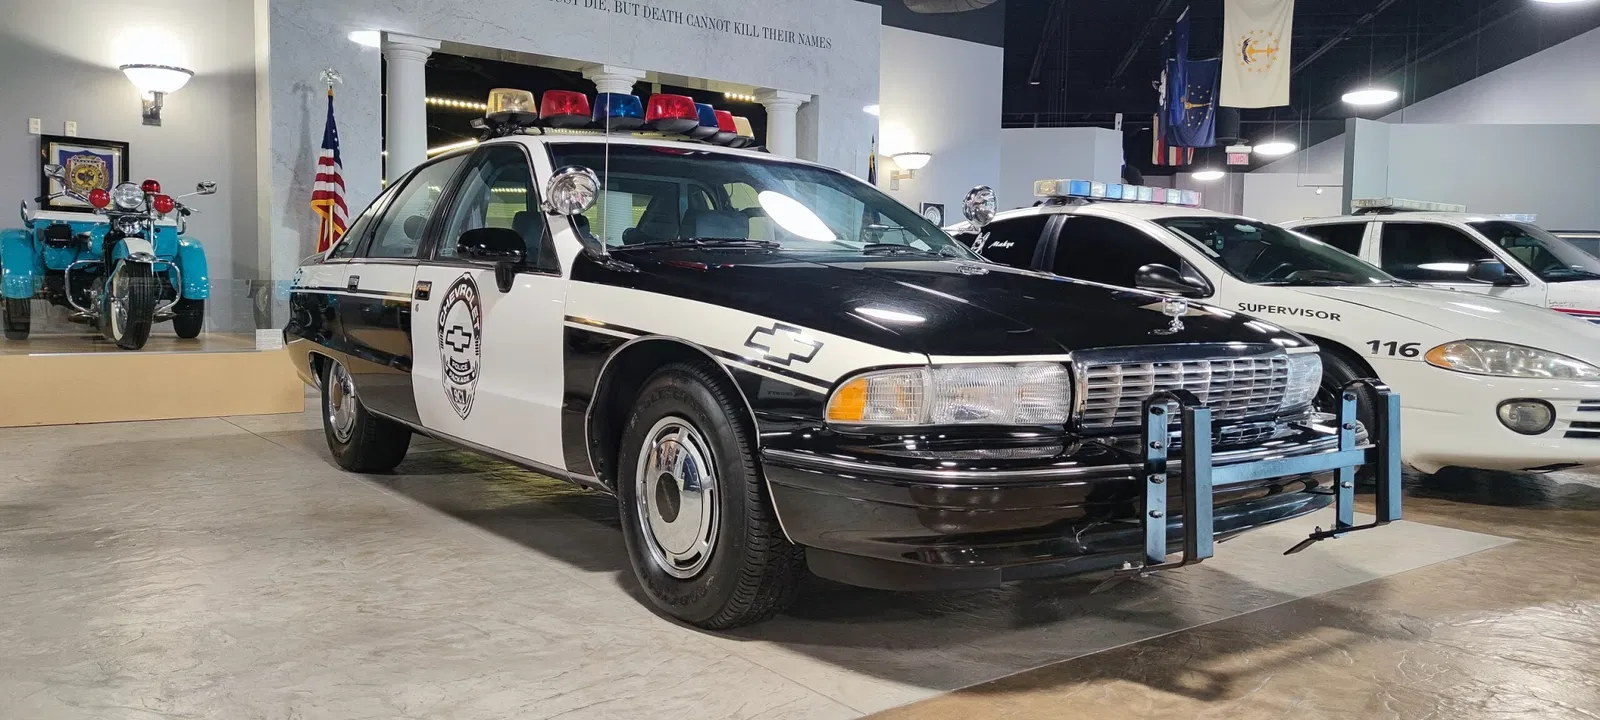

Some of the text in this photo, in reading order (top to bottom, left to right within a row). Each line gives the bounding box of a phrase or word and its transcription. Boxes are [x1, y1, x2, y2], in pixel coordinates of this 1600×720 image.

[615, 0, 640, 16] BUT
[643, 5, 684, 24] DEATH
[686, 13, 731, 32] CANNOT
[734, 22, 760, 37] KILL
[762, 26, 796, 43] THEIR
[798, 32, 832, 49] NAMES
[440, 284, 480, 330] CHEVROLET
[1238, 302, 1341, 321] SUPERVISOR
[1366, 340, 1421, 357] 116
[451, 361, 468, 371] POLICE
[448, 370, 470, 383] PACKAGE
